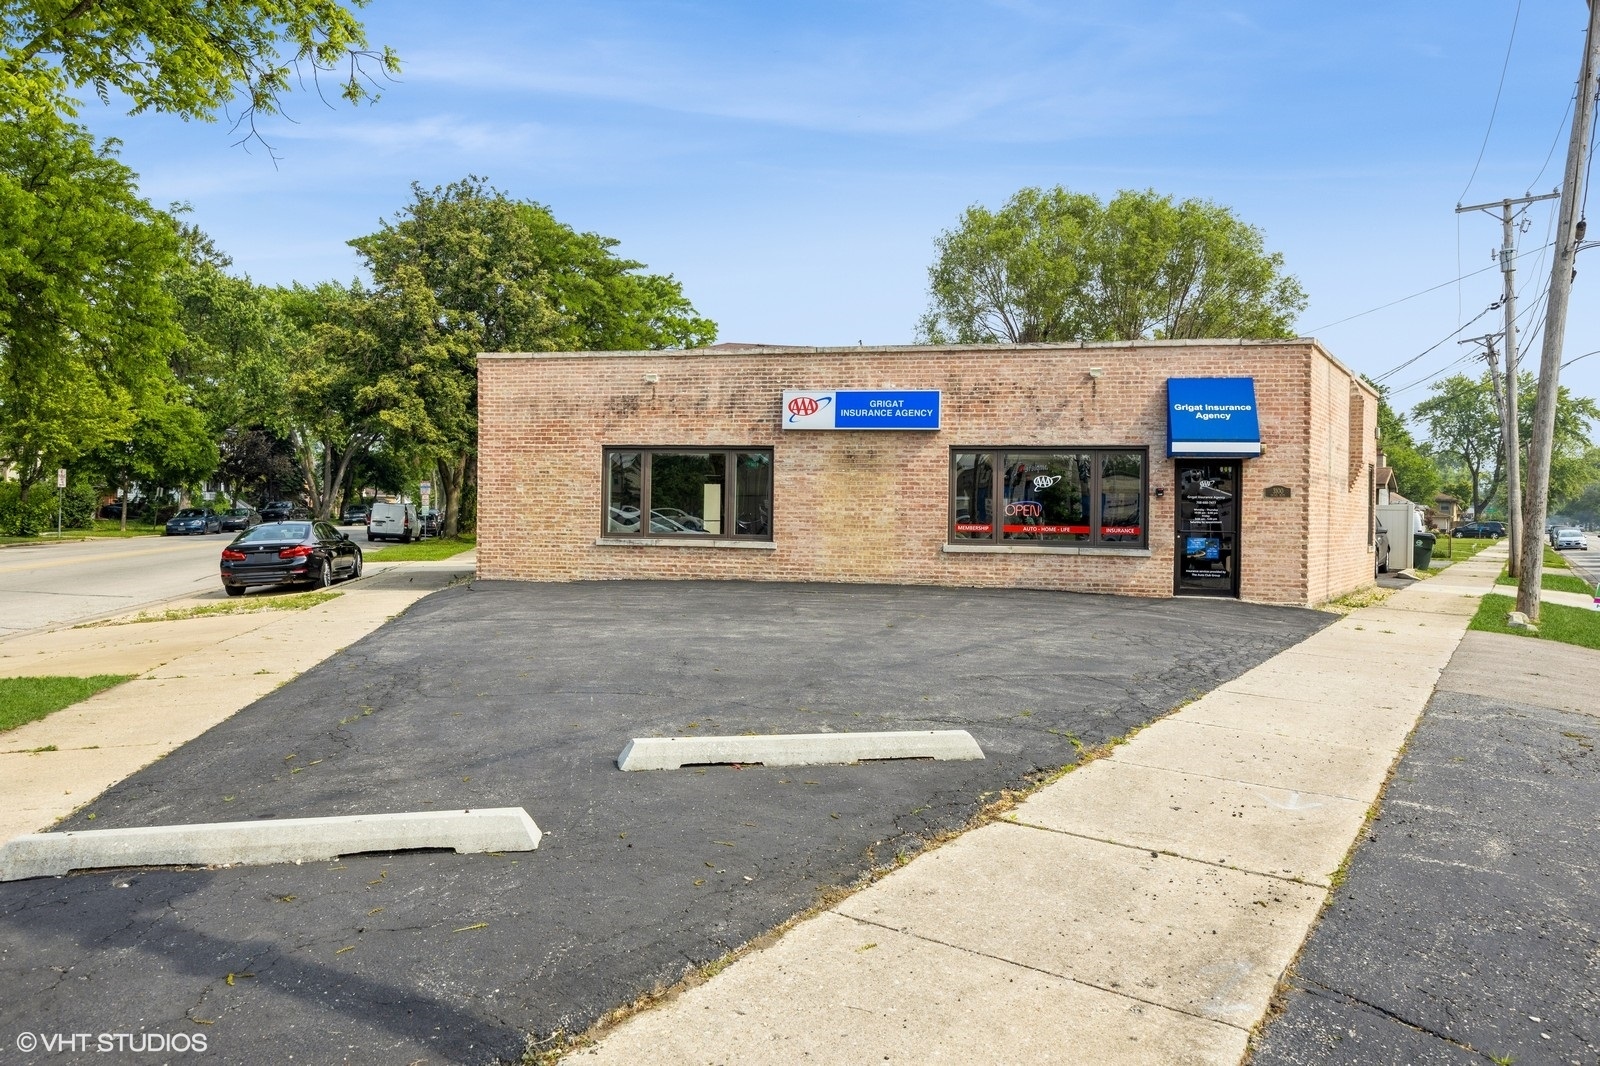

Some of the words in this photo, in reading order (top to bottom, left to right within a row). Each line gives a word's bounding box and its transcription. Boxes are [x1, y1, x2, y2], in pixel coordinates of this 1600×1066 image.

[789, 397, 818, 416] AAA
[869, 400, 904, 408] GRIGAT
[1174, 403, 1203, 412] Grigat
[1204, 403, 1252, 411] Insurance
[840, 409, 893, 417] INSURANCE
[894, 409, 933, 417] AGENCY
[1195, 412, 1231, 421] Agency
[1034, 475, 1053, 488] AAA
[1005, 504, 1041, 517] OPEN
